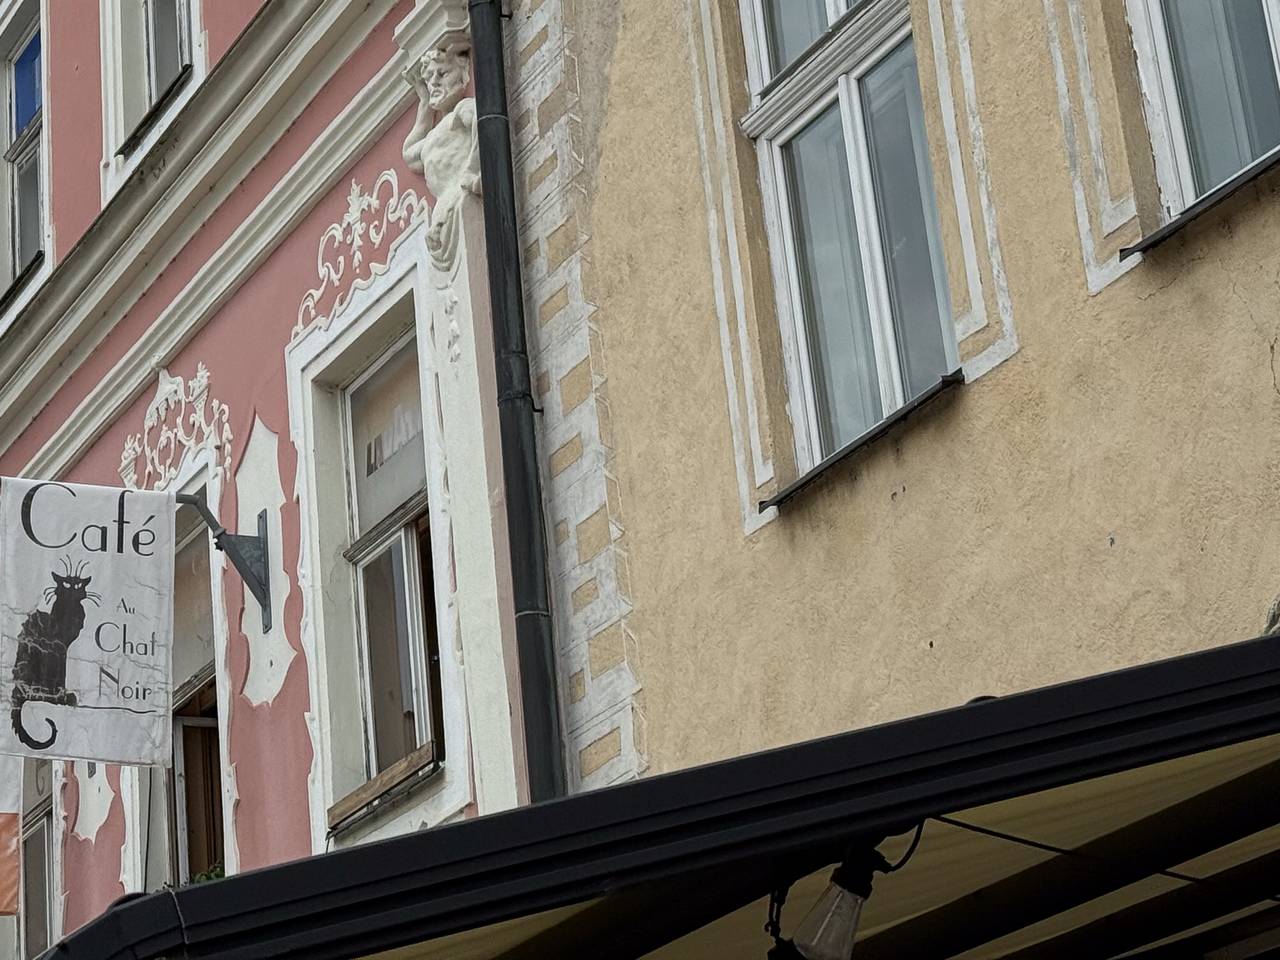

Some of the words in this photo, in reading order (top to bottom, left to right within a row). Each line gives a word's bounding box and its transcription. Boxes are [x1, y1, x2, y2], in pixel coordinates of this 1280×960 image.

[20, 482, 156, 556] Café
[116, 597, 135, 615] Au
[95, 622, 156, 656] Chat
[99, 666, 152, 700] Noir
